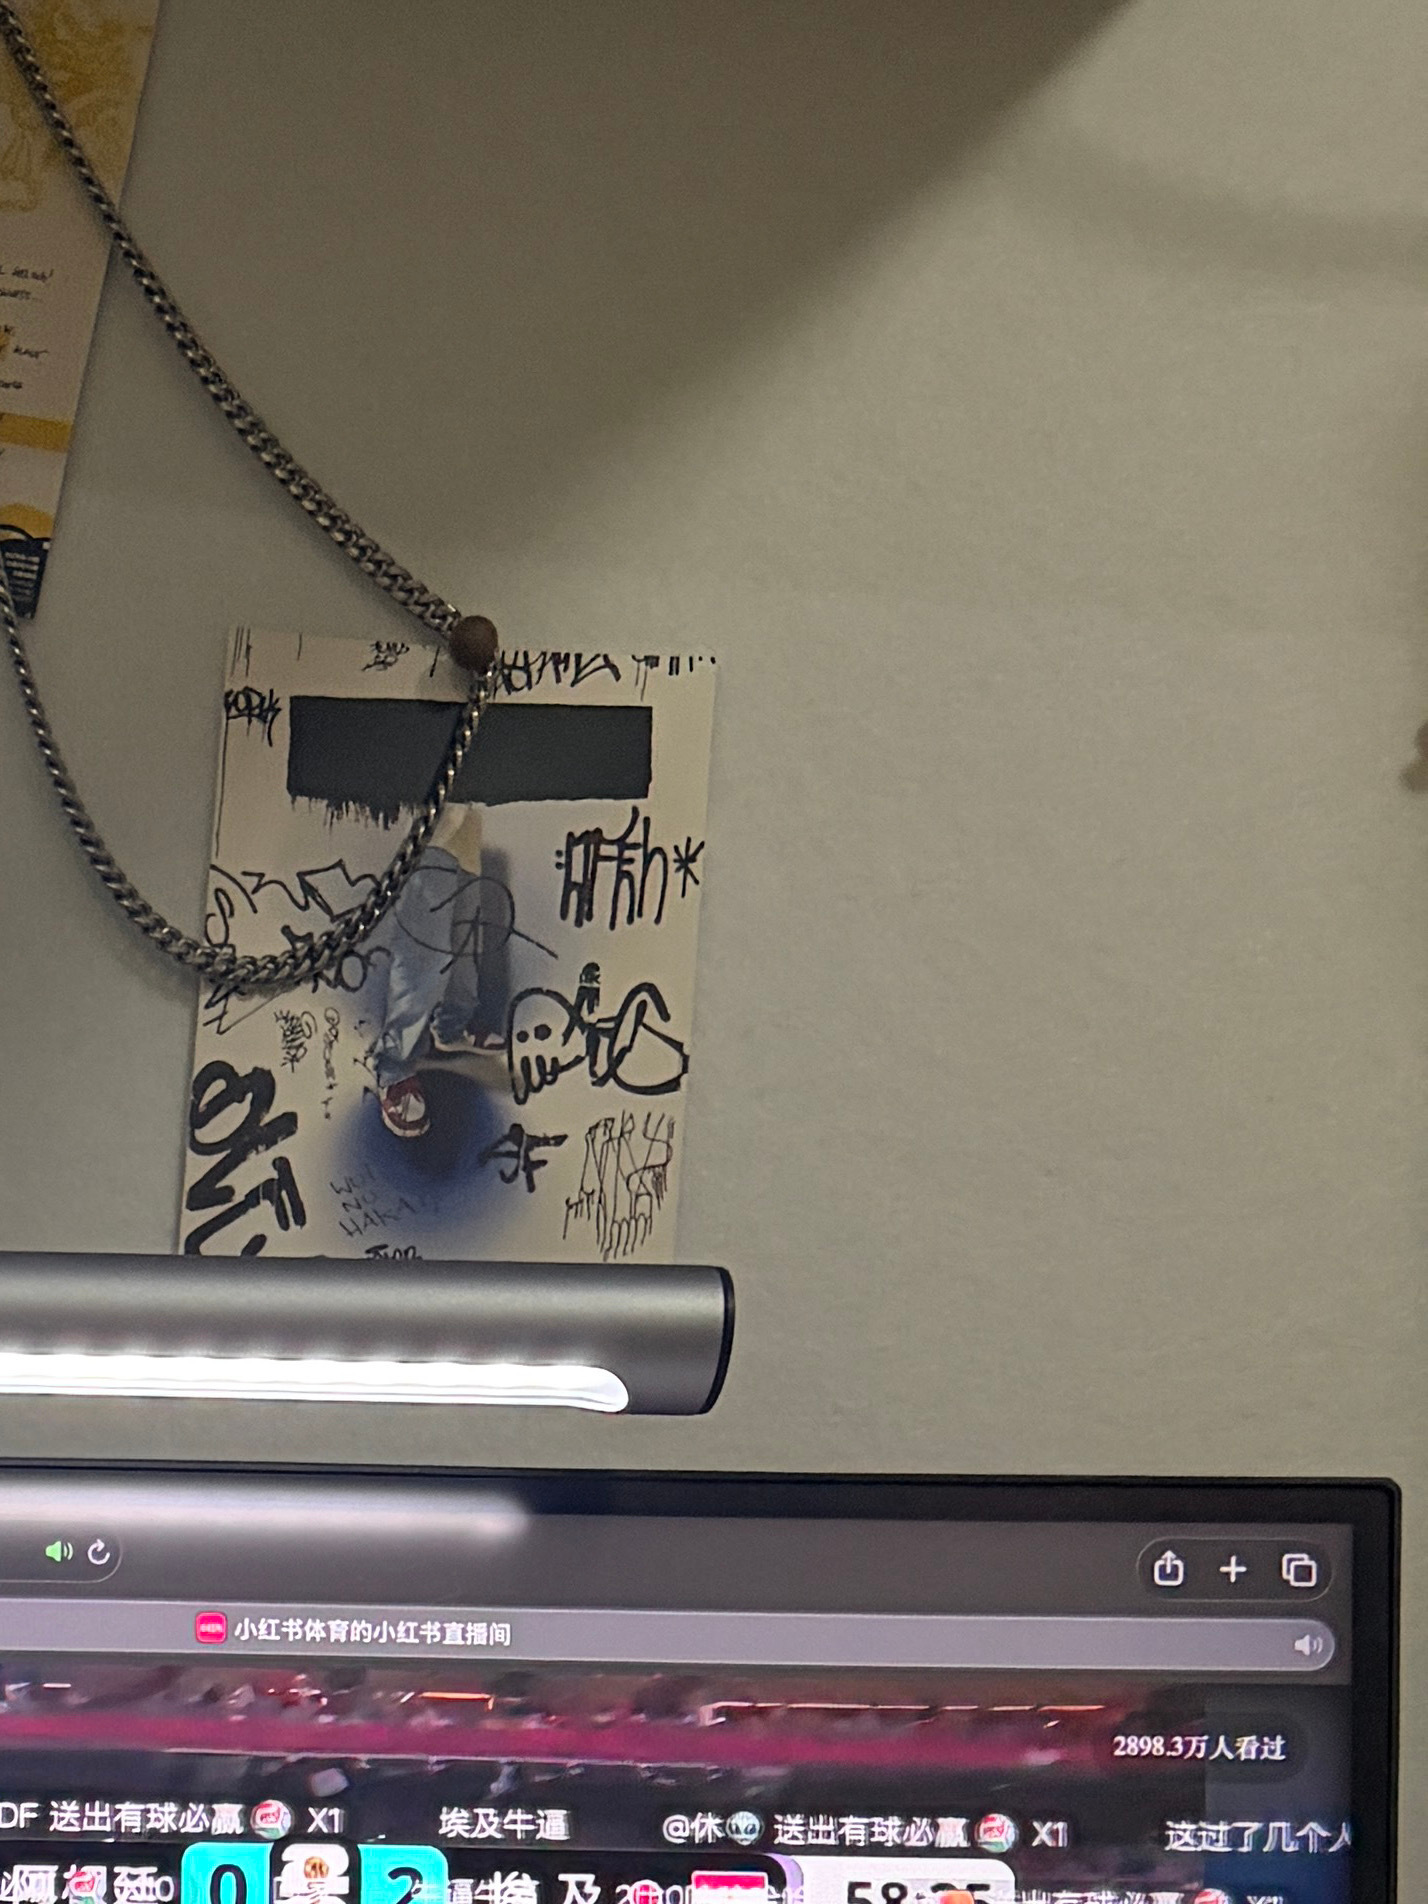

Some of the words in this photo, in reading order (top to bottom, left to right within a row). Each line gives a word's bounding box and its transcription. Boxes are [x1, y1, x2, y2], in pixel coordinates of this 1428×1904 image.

[234, 1618, 512, 1647] 小红书体育的小红书直播间
[1112, 1734, 1287, 1763] 2898.3万人看过
[50, 1802, 244, 1835] 送出有球必赢
[307, 1807, 341, 1833] X1
[439, 1808, 571, 1842] 埃及牛逼
[773, 1814, 971, 1850] 送出有球必赢
